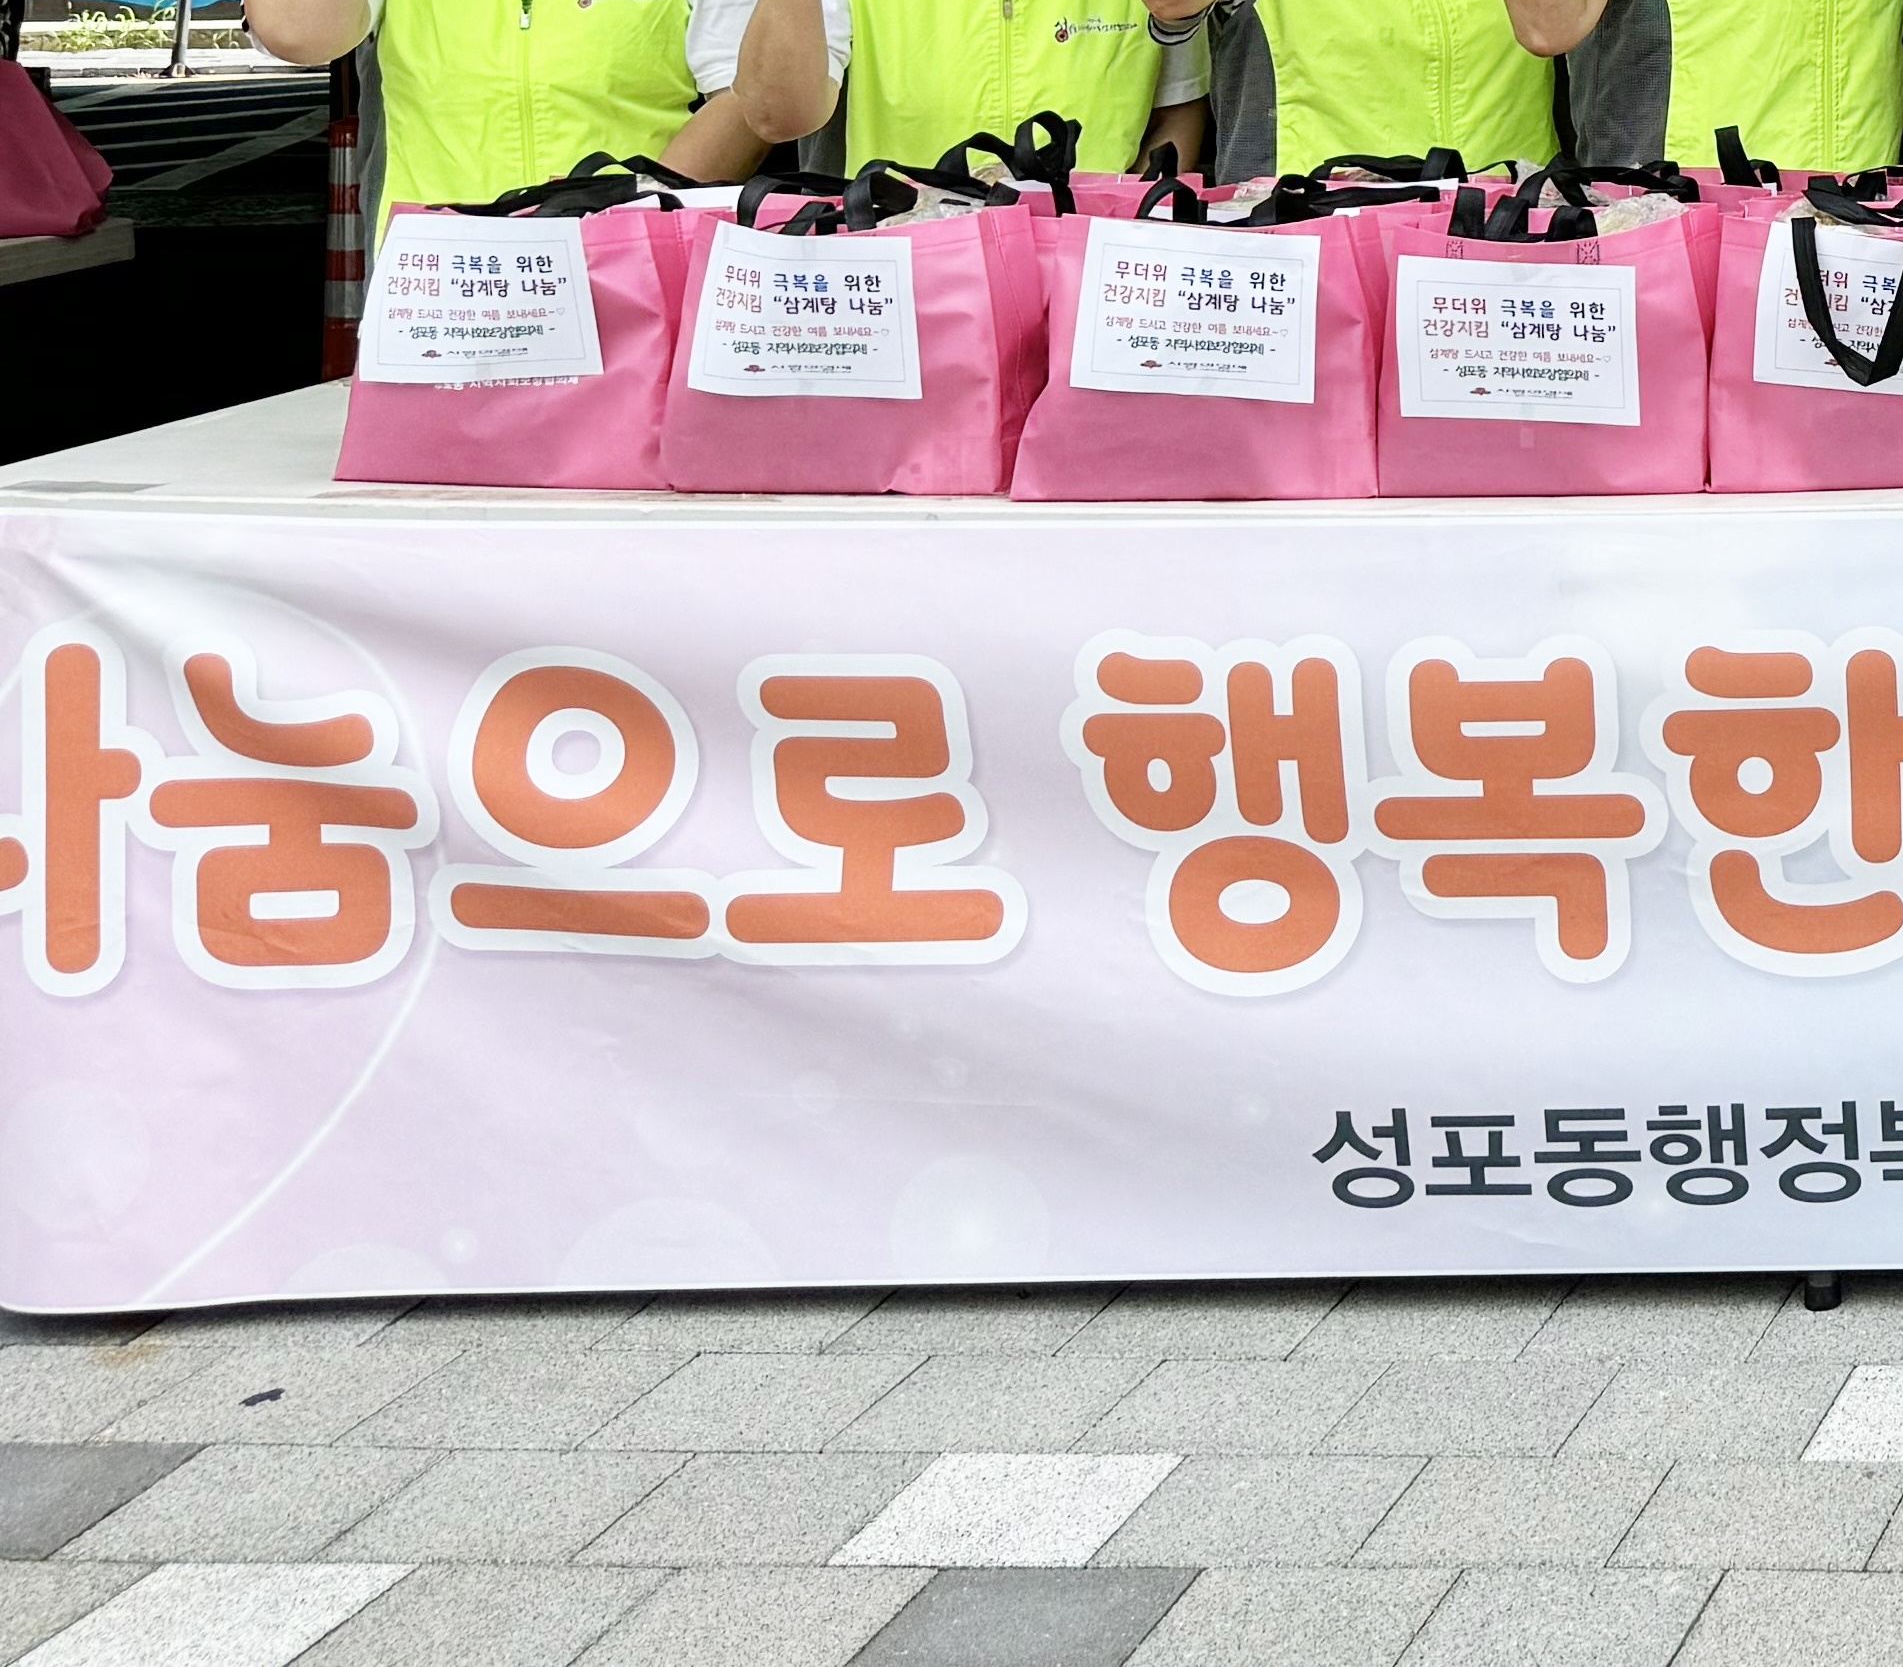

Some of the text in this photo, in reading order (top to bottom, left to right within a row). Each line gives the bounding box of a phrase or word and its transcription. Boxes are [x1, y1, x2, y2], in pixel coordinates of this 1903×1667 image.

[398, 253, 553, 274] 무더위 극복을 위한
[725, 265, 881, 292] 무더위 극복을 위한
[1115, 261, 1286, 292] 무더위 극복을 위한
[1819, 270, 1848, 289] 더위
[1862, 275, 1896, 295] 극복
[1432, 297, 1605, 320] 무더위 극복을 위한
